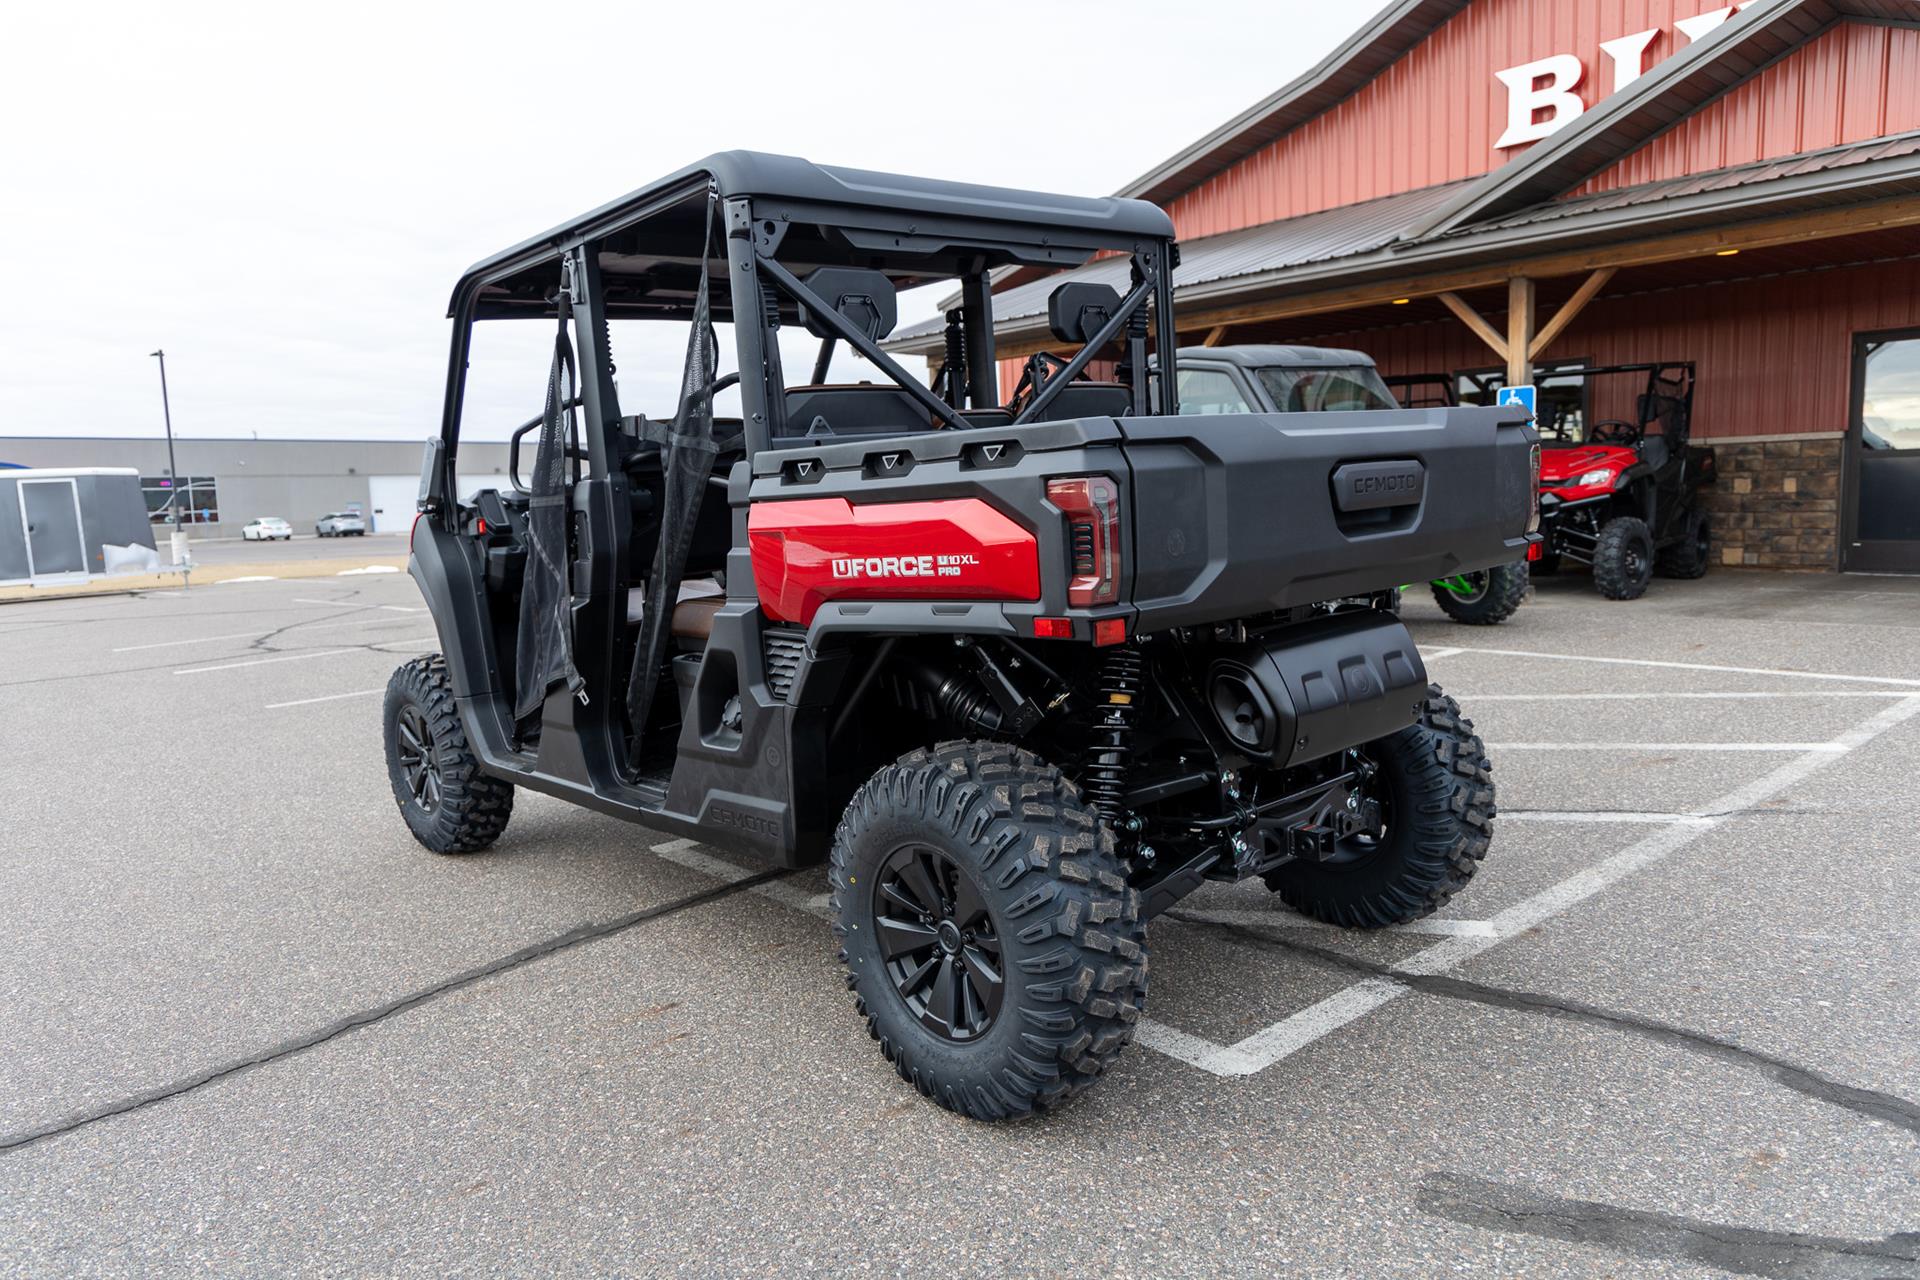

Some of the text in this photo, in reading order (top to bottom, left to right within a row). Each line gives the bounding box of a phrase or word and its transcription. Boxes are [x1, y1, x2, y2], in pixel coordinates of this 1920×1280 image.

[1354, 475, 1416, 494] CFMOTO
[832, 556, 935, 578] UFORCE
[938, 566, 961, 576] PRO
[711, 806, 780, 840] CFMOTO
